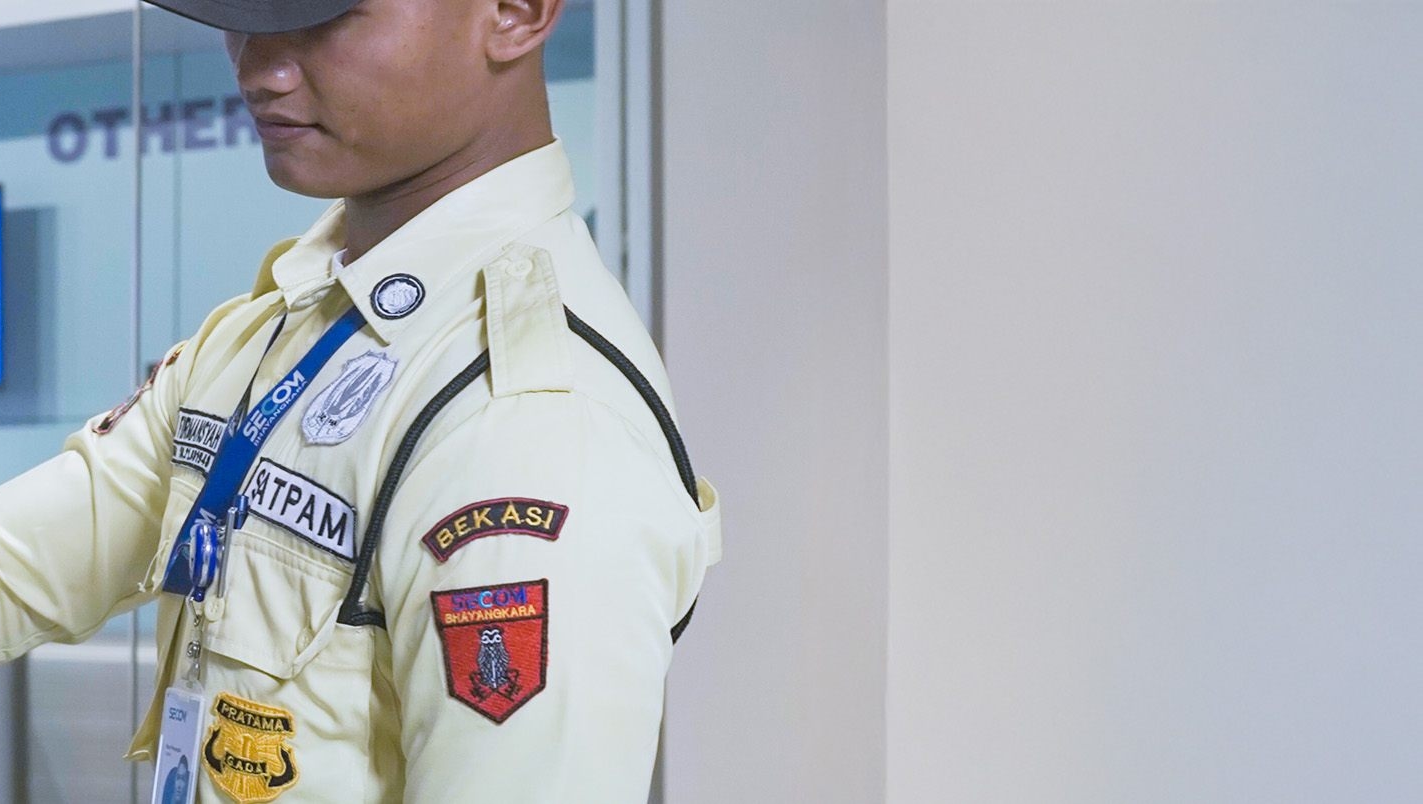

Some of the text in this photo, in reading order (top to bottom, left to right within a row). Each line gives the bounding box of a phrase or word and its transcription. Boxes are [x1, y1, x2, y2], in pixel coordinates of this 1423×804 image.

[243, 369, 306, 442] SECOM
[251, 468, 347, 547] SATPAM
[435, 504, 554, 549] BEKASI
[451, 586, 527, 611] SECOM
[445, 604, 537, 625] BHAYANGKARA
[221, 703, 285, 732] PRATAMA
[227, 755, 263, 774] GADA
